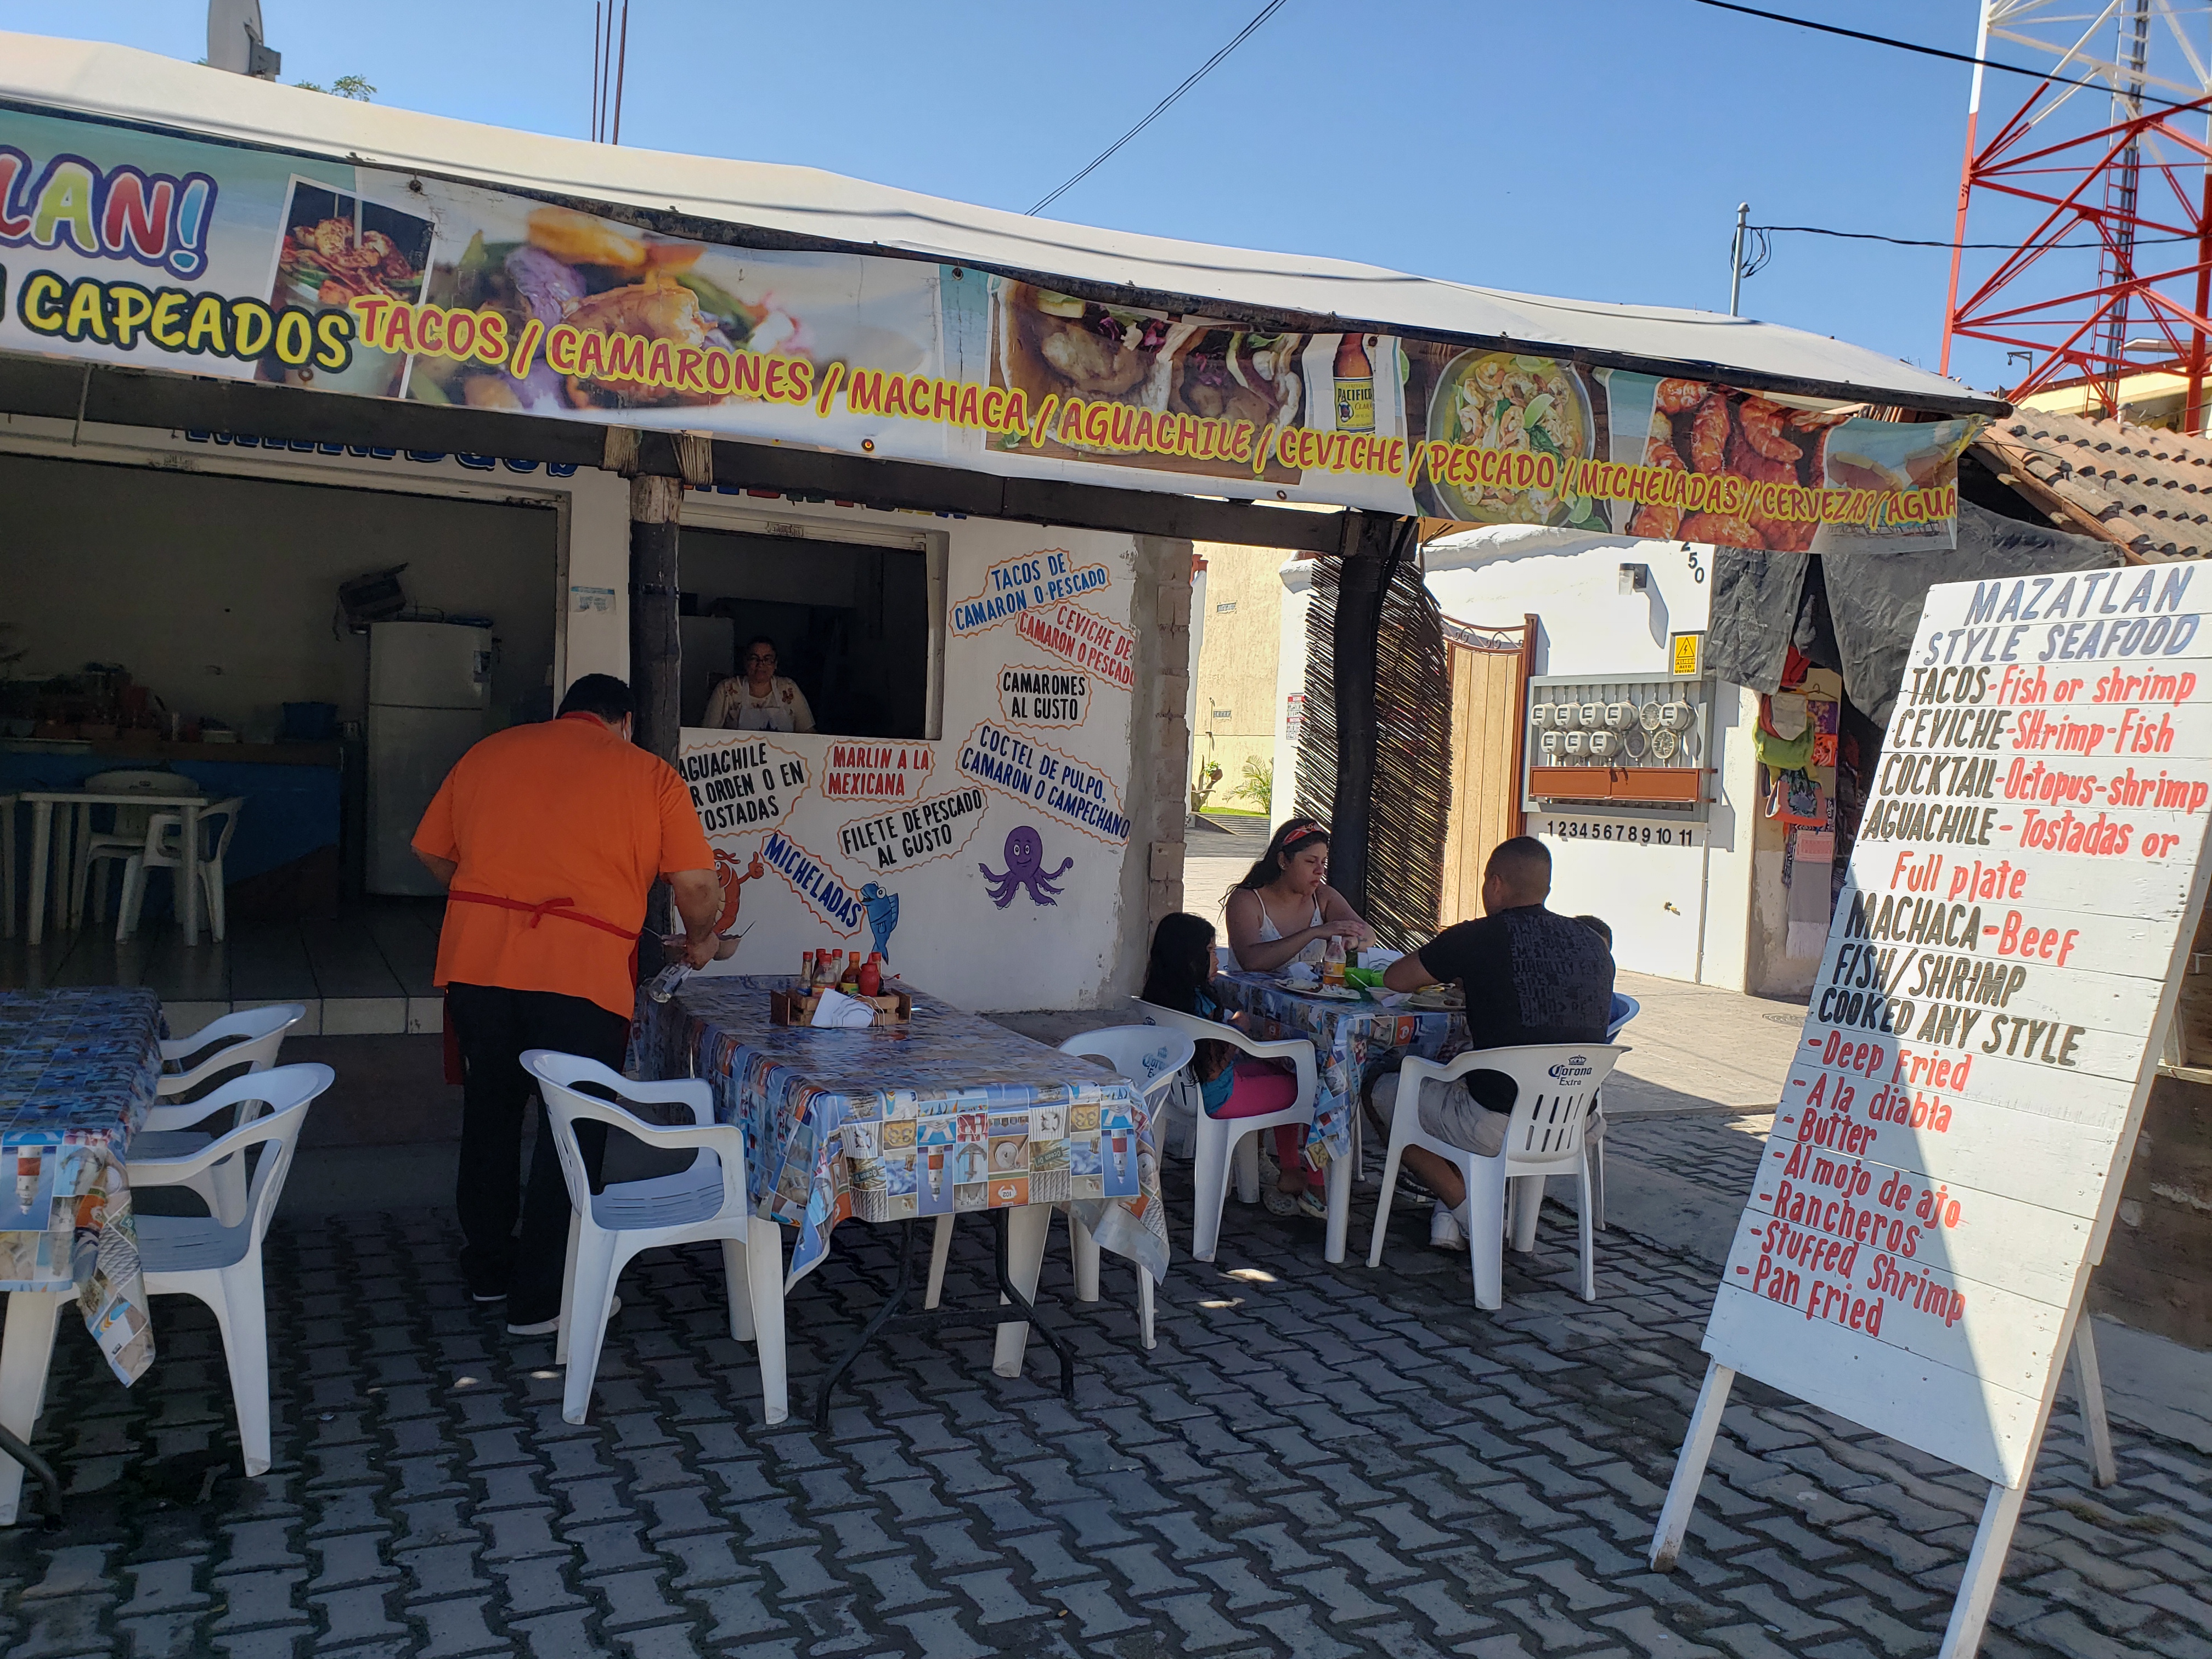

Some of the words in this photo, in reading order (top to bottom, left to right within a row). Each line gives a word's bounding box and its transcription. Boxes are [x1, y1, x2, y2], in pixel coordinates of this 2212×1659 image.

[22, 273, 353, 371] CAPEADOS
[352, 297, 506, 362] TACOS
[550, 331, 814, 404] CAMARONES
[849, 369, 1027, 433] MACHACA
[1060, 400, 1252, 461] AGUACHILE
[1278, 428, 1405, 477] CEVICHE
[1429, 442, 1556, 490] PESCADO
[1578, 463, 1743, 512] MICHELADAS
[1762, 484, 1876, 522] CERVEZAS
[1887, 485, 1957, 524] AGUA
[991, 560, 1041, 591] TACOS
[1047, 552, 1066, 576] DE
[1963, 566, 2195, 627] MAZATLAN
[955, 589, 1028, 631] CAMARON
[1034, 585, 1043, 603] O
[1047, 567, 1106, 601] PESCADO
[1019, 611, 1076, 658] CAMARON
[1077, 642, 1087, 663] O
[1057, 605, 1115, 651] CEVICHE
[1114, 635, 1134, 661] DE
[1923, 624, 2030, 666] STYLE
[2038, 614, 2200, 661] SEAFOOD
[1003, 671, 1086, 696] CAMARONES
[1011, 696, 1028, 718] AL
[1034, 697, 1078, 721] GUSTO
[2052, 678, 2084, 703] or
[2091, 666, 2197, 707] shrimp
[679, 742, 768, 782] AGUACHILE
[705, 772, 755, 804] ORDEN
[763, 769, 775, 791] O
[781, 760, 805, 788] EN
[828, 772, 905, 796] MEXICANA
[832, 745, 893, 769] MARLIN
[897, 748, 908, 770] A
[913, 748, 929, 771] LA
[979, 725, 1033, 769] COCTEL
[1039, 754, 1059, 781] DE
[1061, 765, 1107, 804] PULPO,
[961, 747, 1032, 794] CAMARON
[1034, 780, 1046, 800] O
[1047, 786, 1131, 839] CAMPECHANO
[842, 816, 898, 855] FILETE
[877, 845, 898, 868] AL
[901, 823, 952, 857] GUSTO
[2019, 808, 2134, 856] Tostadas
[2141, 831, 2180, 859] or
[764, 832, 863, 928] MICHELADAS
[1889, 850, 1944, 892] Full
[1947, 859, 2028, 903] plate
[1817, 987, 1916, 1036] COOKED
[1917, 1003, 1982, 1050] ANY
[1981, 1013, 2086, 1068] STYLE
[1548, 1063, 1593, 1080] Corona
[1558, 1077, 1582, 1086] Extra
[1891, 1048, 1972, 1092] Fried
[1833, 1075, 1856, 1114] la
[1868, 1084, 1953, 1133] diabla
[1811, 1156, 1872, 1199] mojo
[1877, 1170, 1912, 1211] de
[1915, 1184, 1962, 1229] ajo
[1805, 1279, 1885, 1338] Fried
[1866, 1253, 1967, 1328] Shrimp
